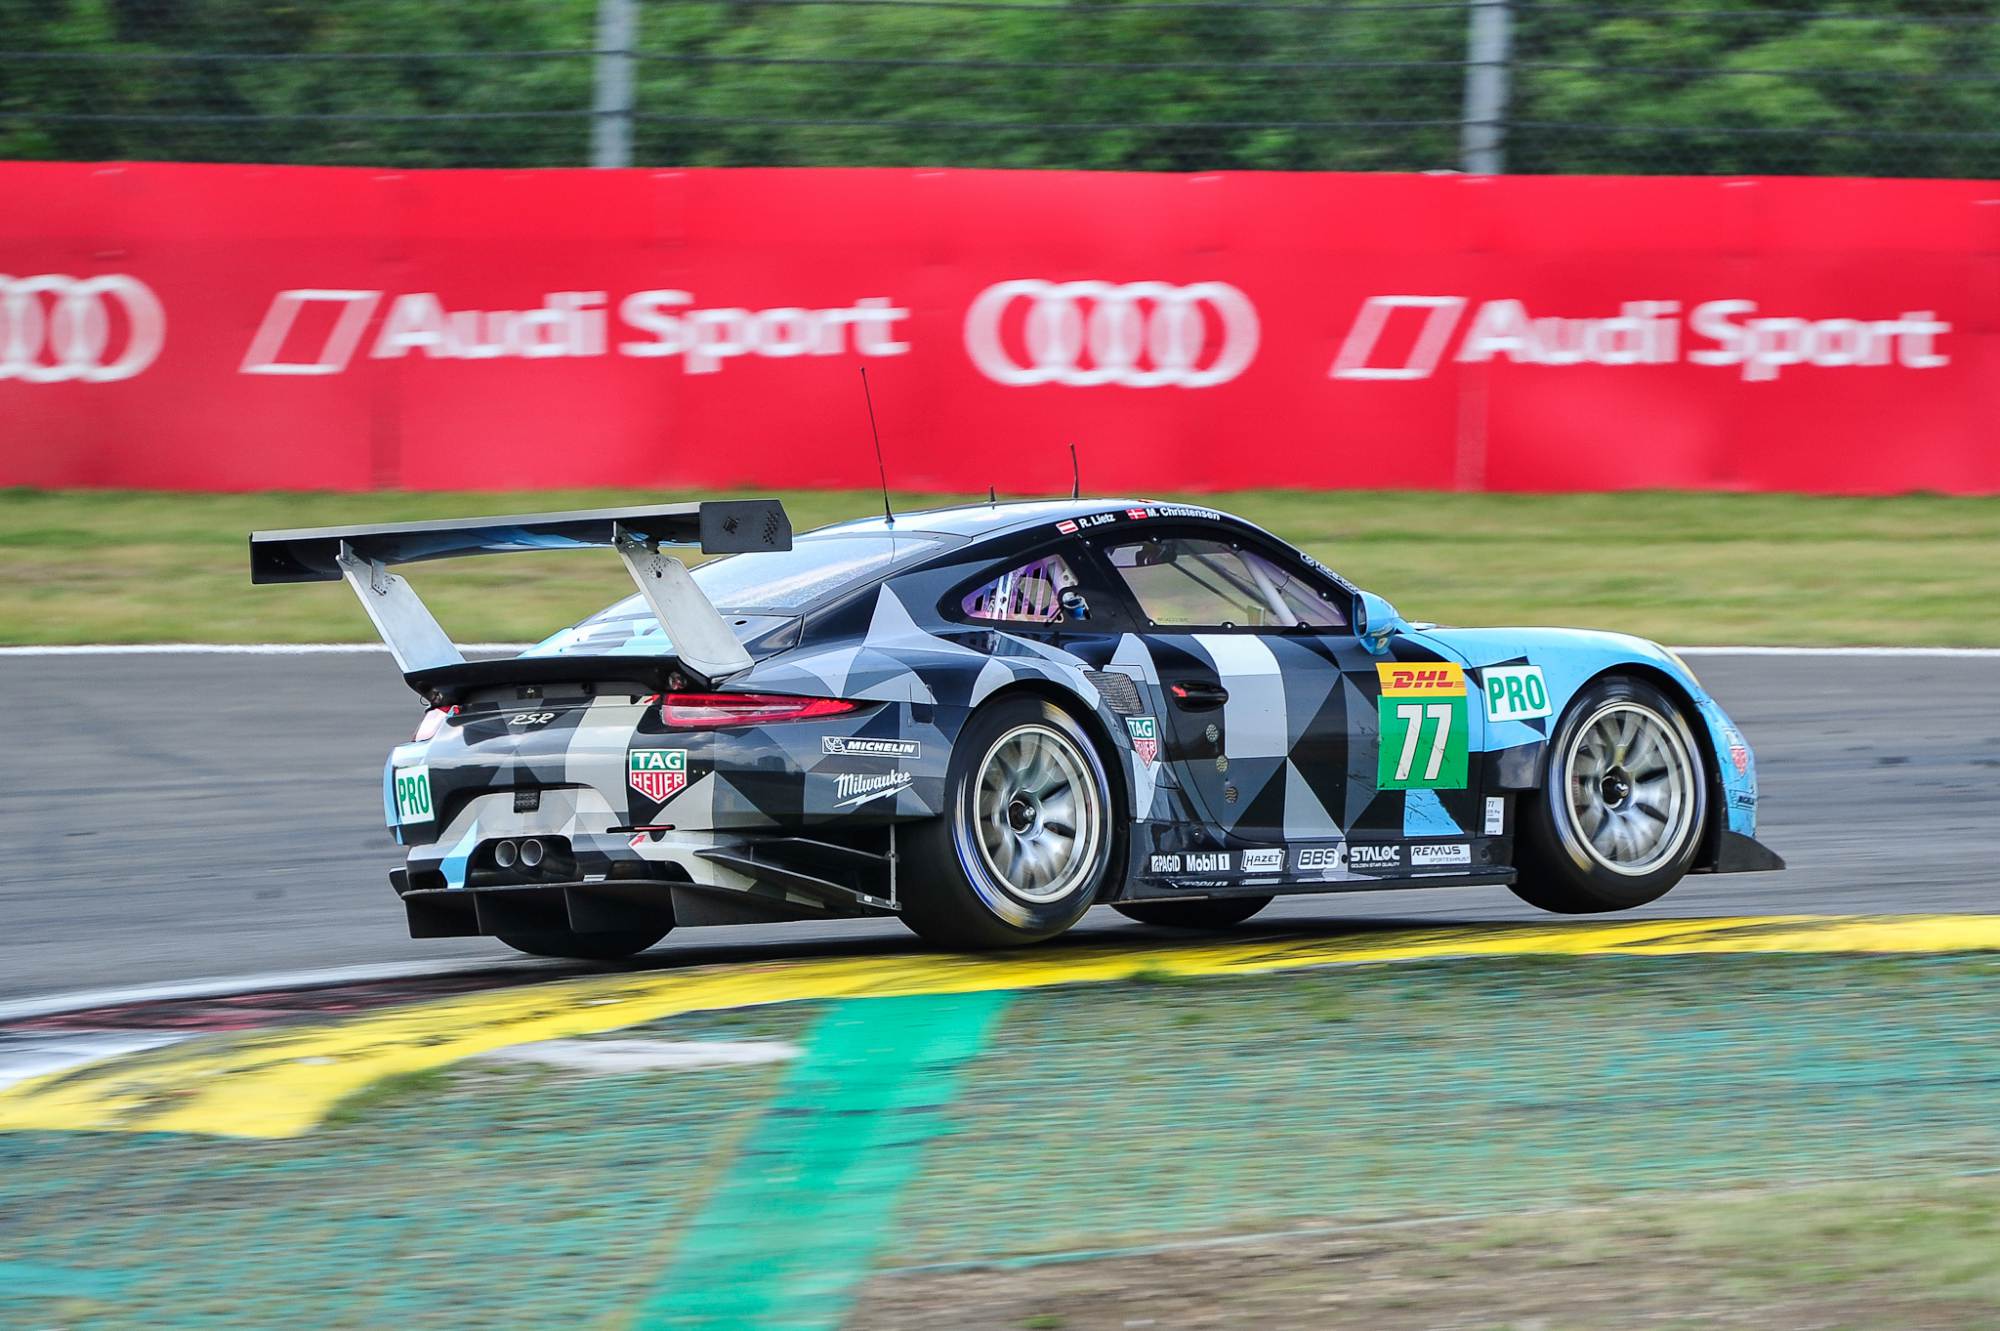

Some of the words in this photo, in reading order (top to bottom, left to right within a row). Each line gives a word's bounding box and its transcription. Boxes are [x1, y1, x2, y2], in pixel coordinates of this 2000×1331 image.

[371, 291, 608, 358] Audi
[618, 289, 911, 374] Sport
[1454, 299, 1680, 365] Audi
[1688, 299, 1951, 381] Sport
[1078, 517, 1092, 529] R.
[1092, 513, 1116, 526] Lietz
[1146, 507, 1159, 518] M.
[1161, 507, 1221, 521] Christensen
[1392, 670, 1454, 689] DHL
[1487, 674, 1546, 714] PRO
[508, 712, 555, 726] RSR
[1127, 720, 1153, 737] TAG
[846, 741, 915, 754] MICHELIN
[1394, 703, 1453, 781] 77
[633, 752, 682, 769] TAG
[632, 773, 684, 799] HEUER
[833, 769, 912, 799] Milwaukee
[397, 774, 430, 817] PRO
[1298, 849, 1338, 868] BBS
[1350, 846, 1400, 862] STALOC
[1412, 845, 1461, 857] REMUS
[1159, 854, 1181, 872] PAGID
[1186, 853, 1217, 872] Mobil
[1246, 854, 1280, 867] HAZET
